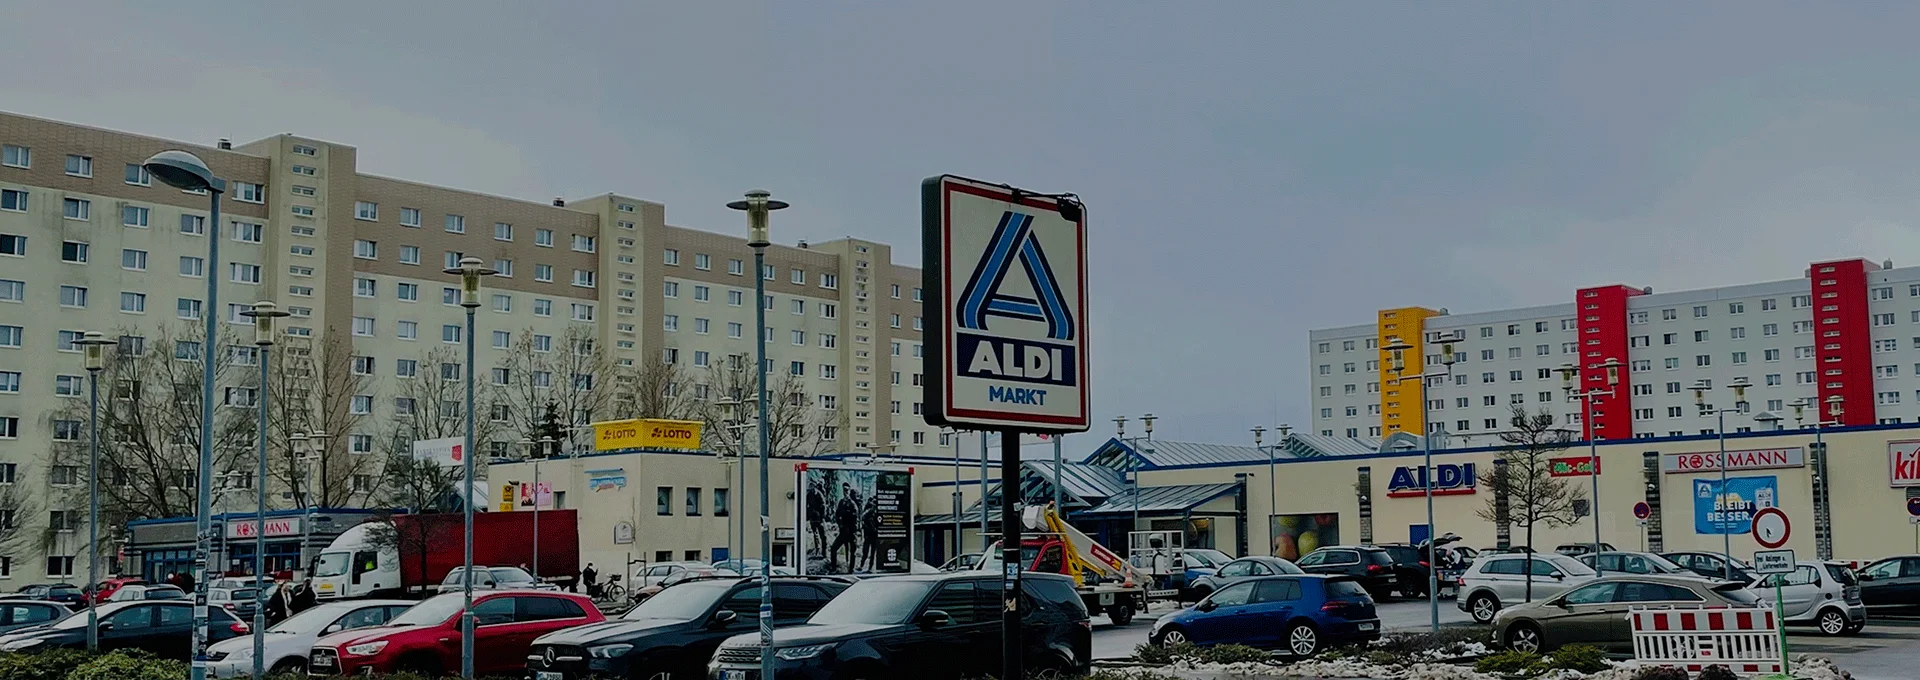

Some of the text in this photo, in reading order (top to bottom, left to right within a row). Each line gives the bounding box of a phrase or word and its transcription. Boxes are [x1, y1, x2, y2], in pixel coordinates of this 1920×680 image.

[968, 339, 1063, 381] ALDI
[989, 385, 1047, 406] MARKT
[612, 429, 637, 439] LOTTO
[663, 429, 692, 439] LOTTO
[1678, 451, 1787, 470] ROSSMANN
[1388, 462, 1476, 490] ALDI
[1713, 500, 1752, 511] BLEIBT
